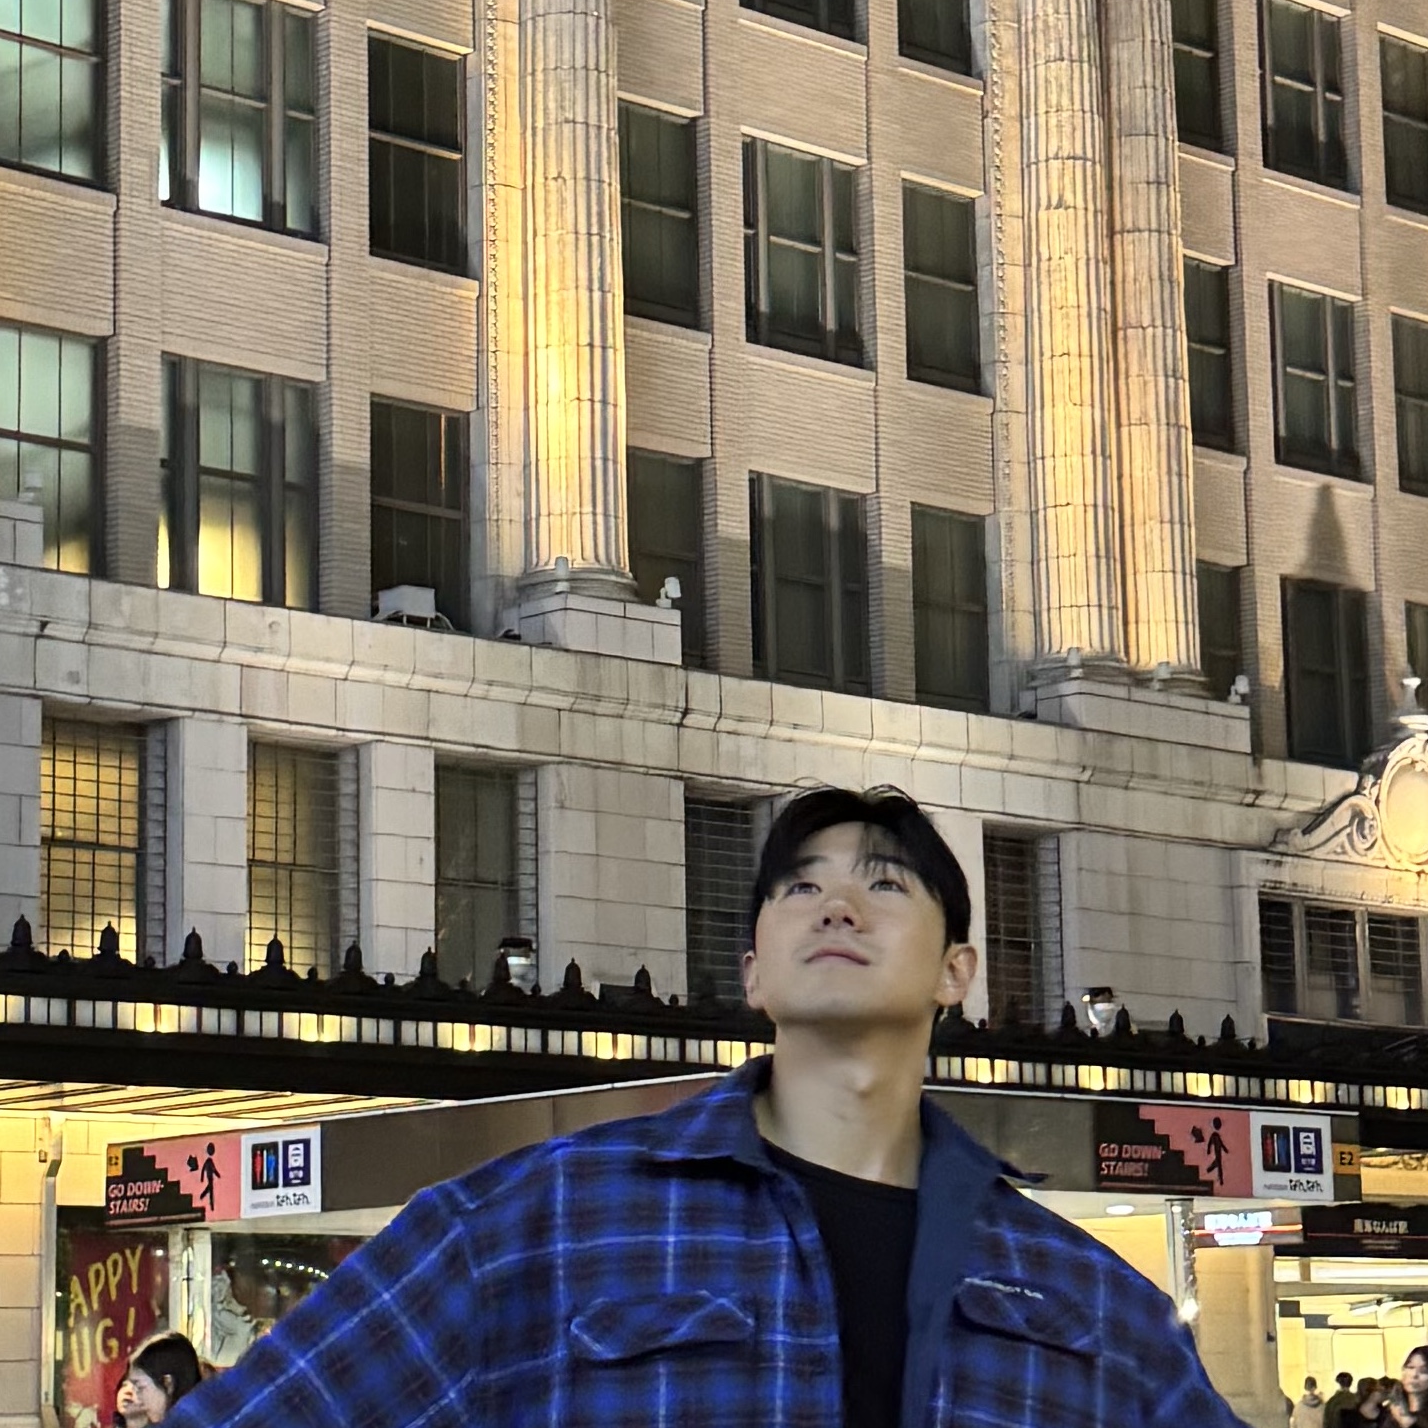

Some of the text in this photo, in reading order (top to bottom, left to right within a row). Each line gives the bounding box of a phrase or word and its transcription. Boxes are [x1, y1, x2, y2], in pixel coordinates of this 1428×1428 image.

[1099, 1143, 1166, 1160] GO DOWN-
[1339, 1152, 1355, 1166] E2
[1099, 1161, 1149, 1177] STAIRS!
[108, 1179, 164, 1199] GO DOWN-
[108, 1198, 150, 1215] STAIRS!
